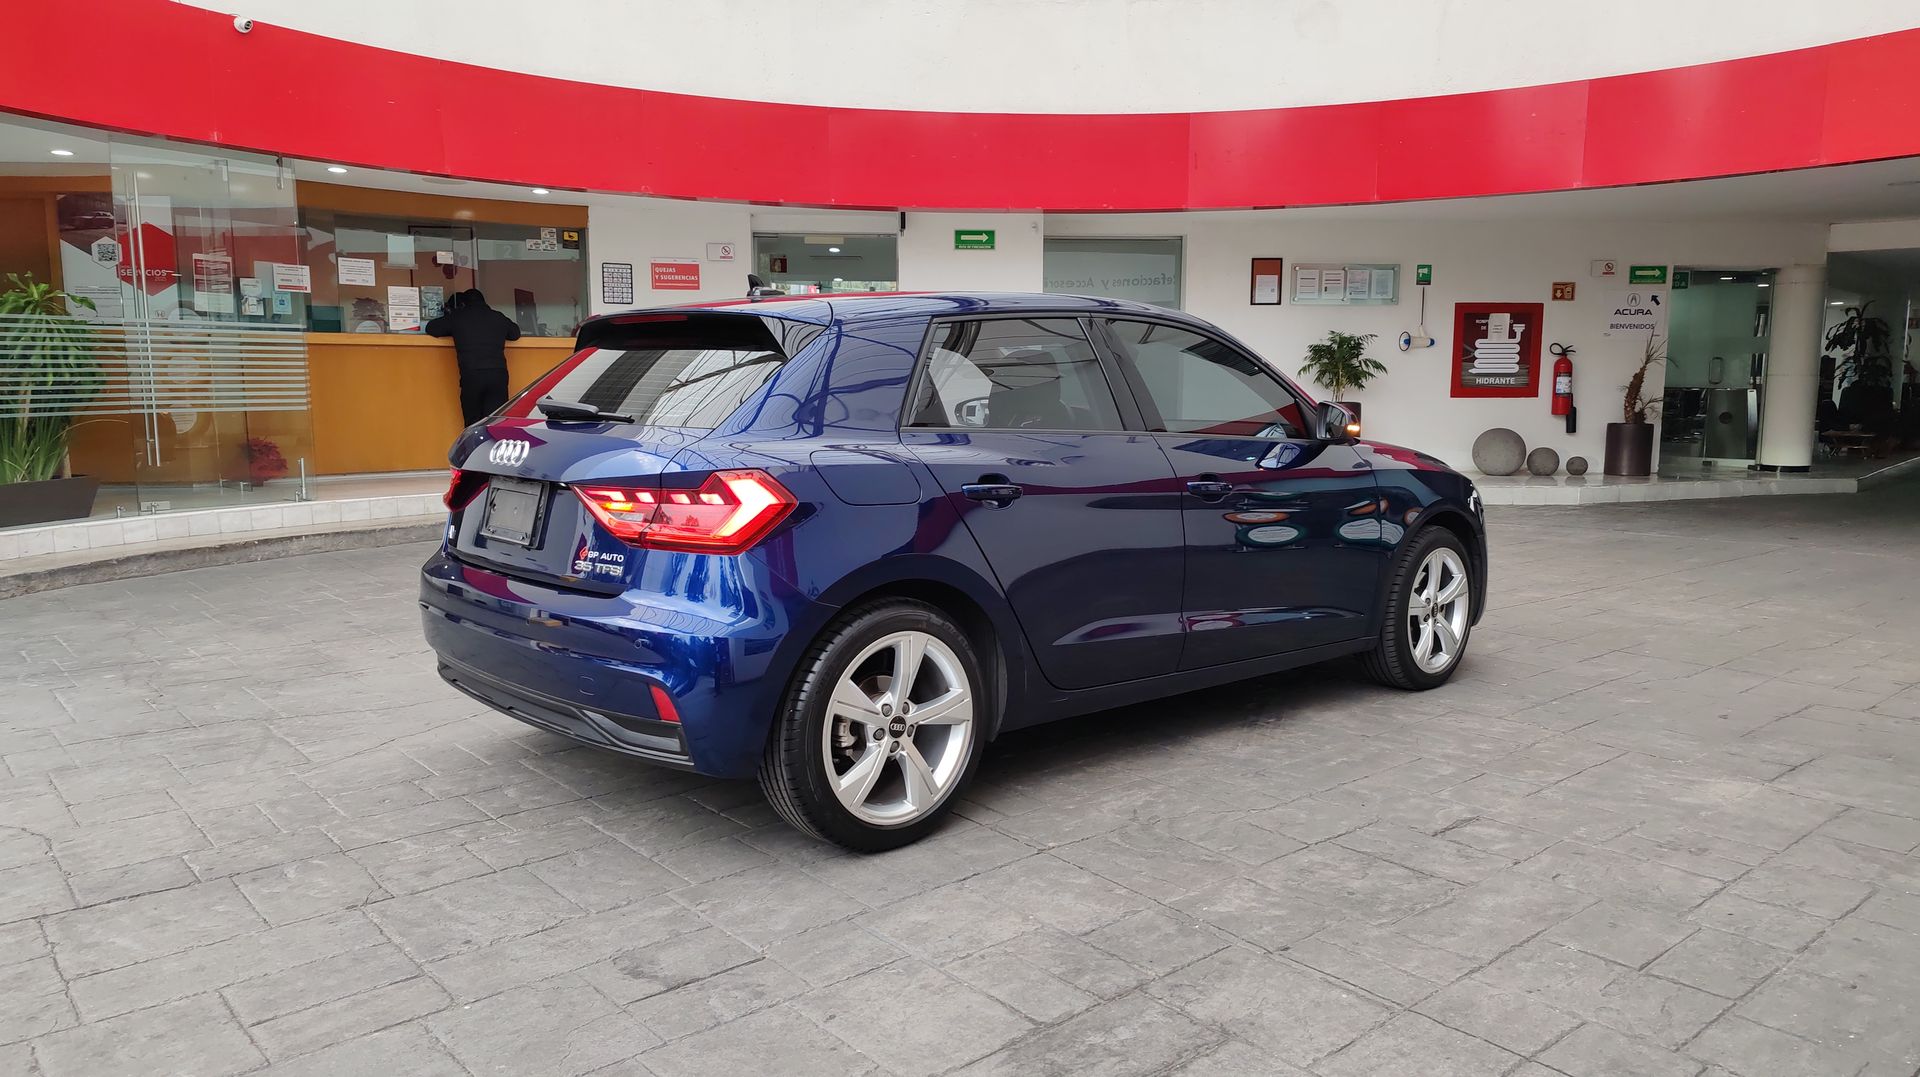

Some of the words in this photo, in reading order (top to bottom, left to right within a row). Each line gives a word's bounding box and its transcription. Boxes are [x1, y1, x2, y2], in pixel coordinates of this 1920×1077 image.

[600, 552, 624, 562] AUTO
[574, 560, 592, 572] 35
[594, 562, 624, 576] TFSI
